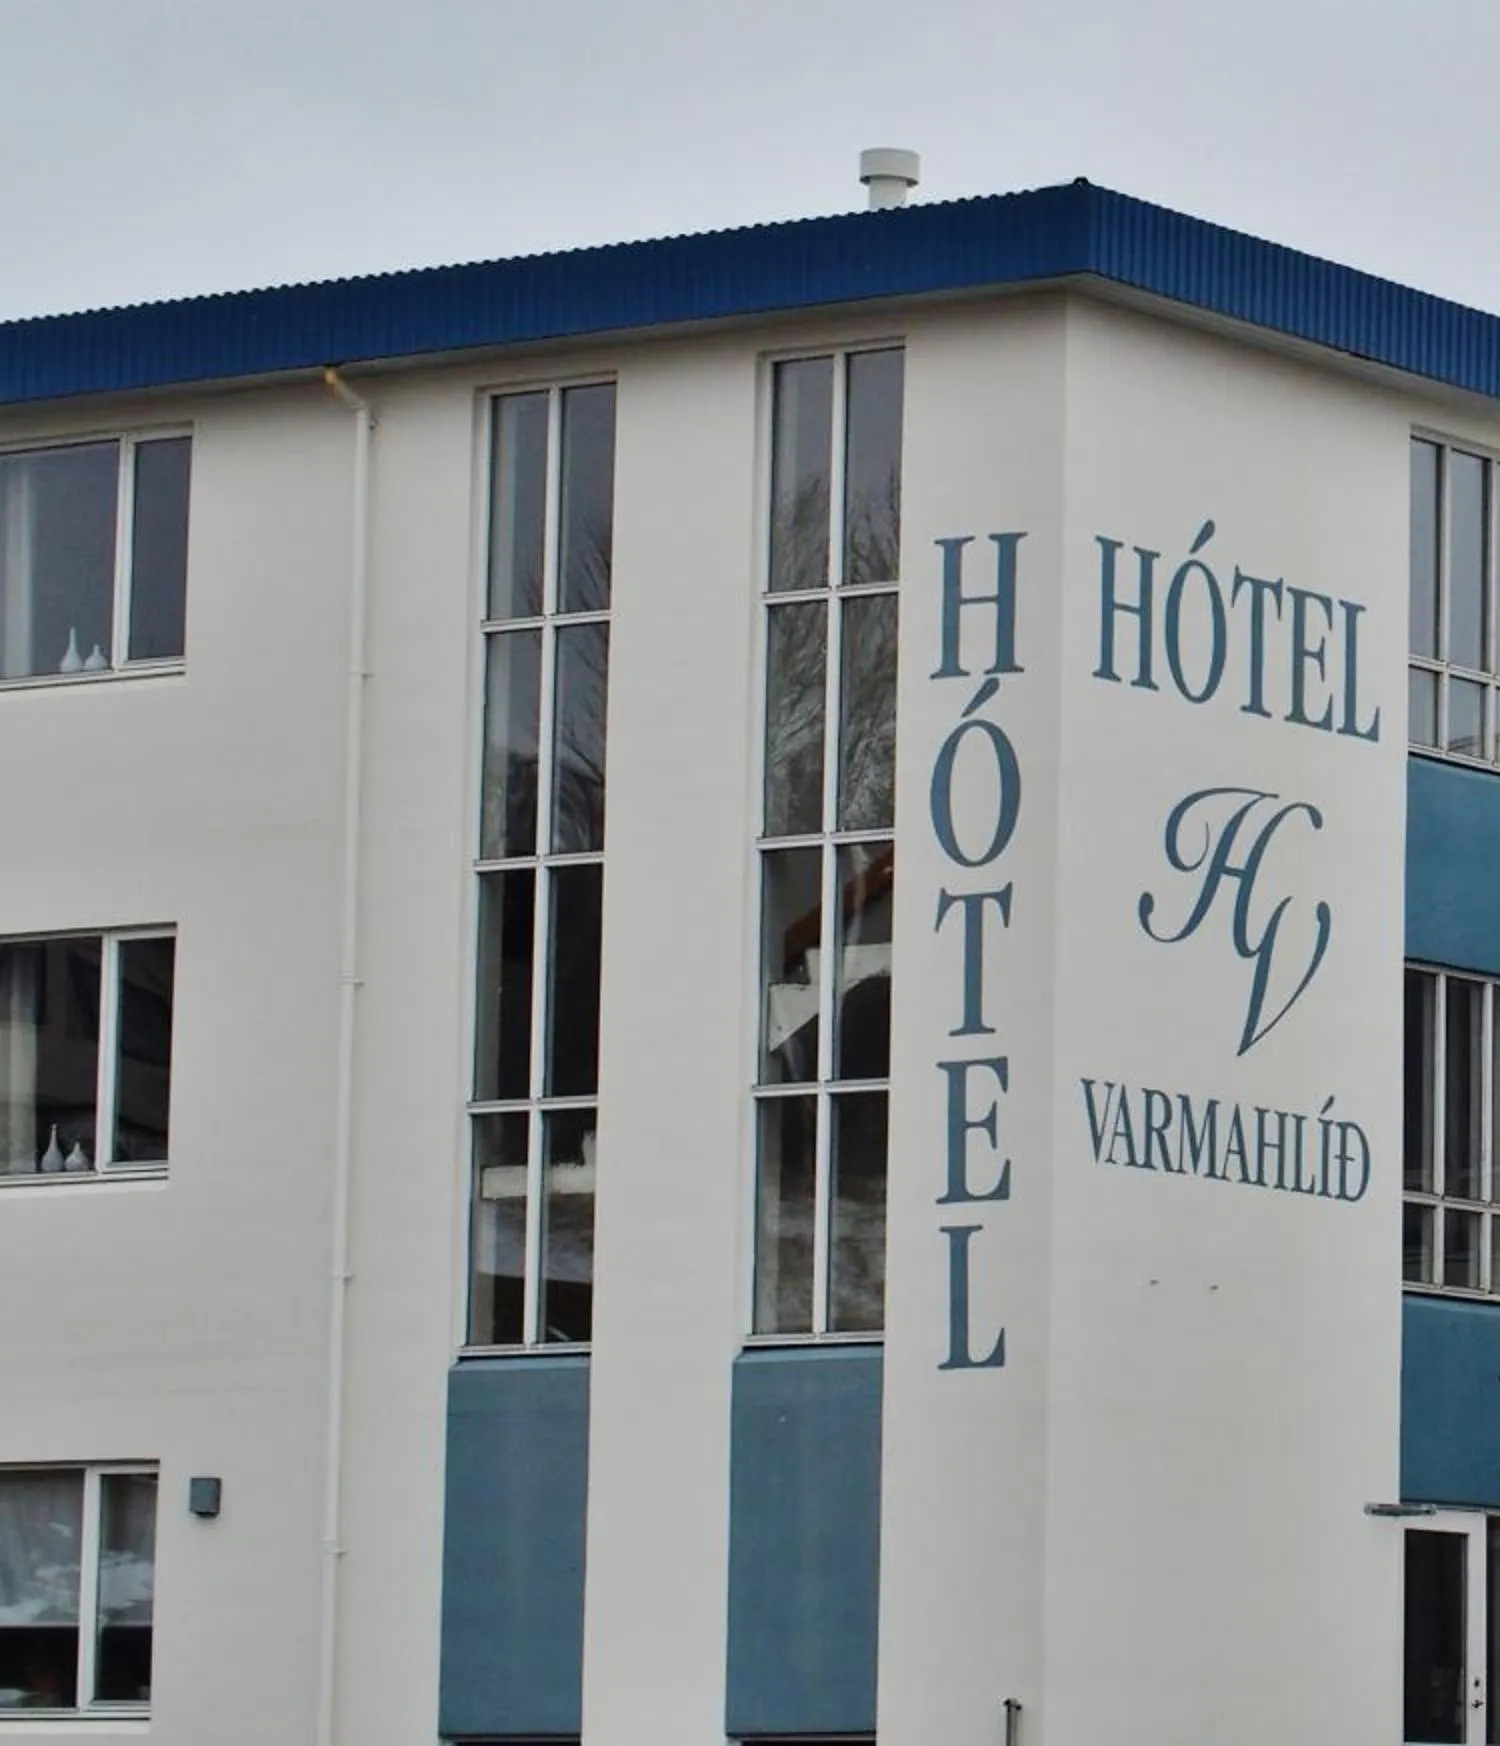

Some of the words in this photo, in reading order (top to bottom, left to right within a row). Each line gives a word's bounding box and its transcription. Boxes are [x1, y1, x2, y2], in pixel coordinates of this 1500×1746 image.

[1092, 520, 1382, 743] HÓTEL
[929, 531, 1027, 1371] HÓTEL
[1080, 1078, 1371, 1203] VARMAHLÍÐ
